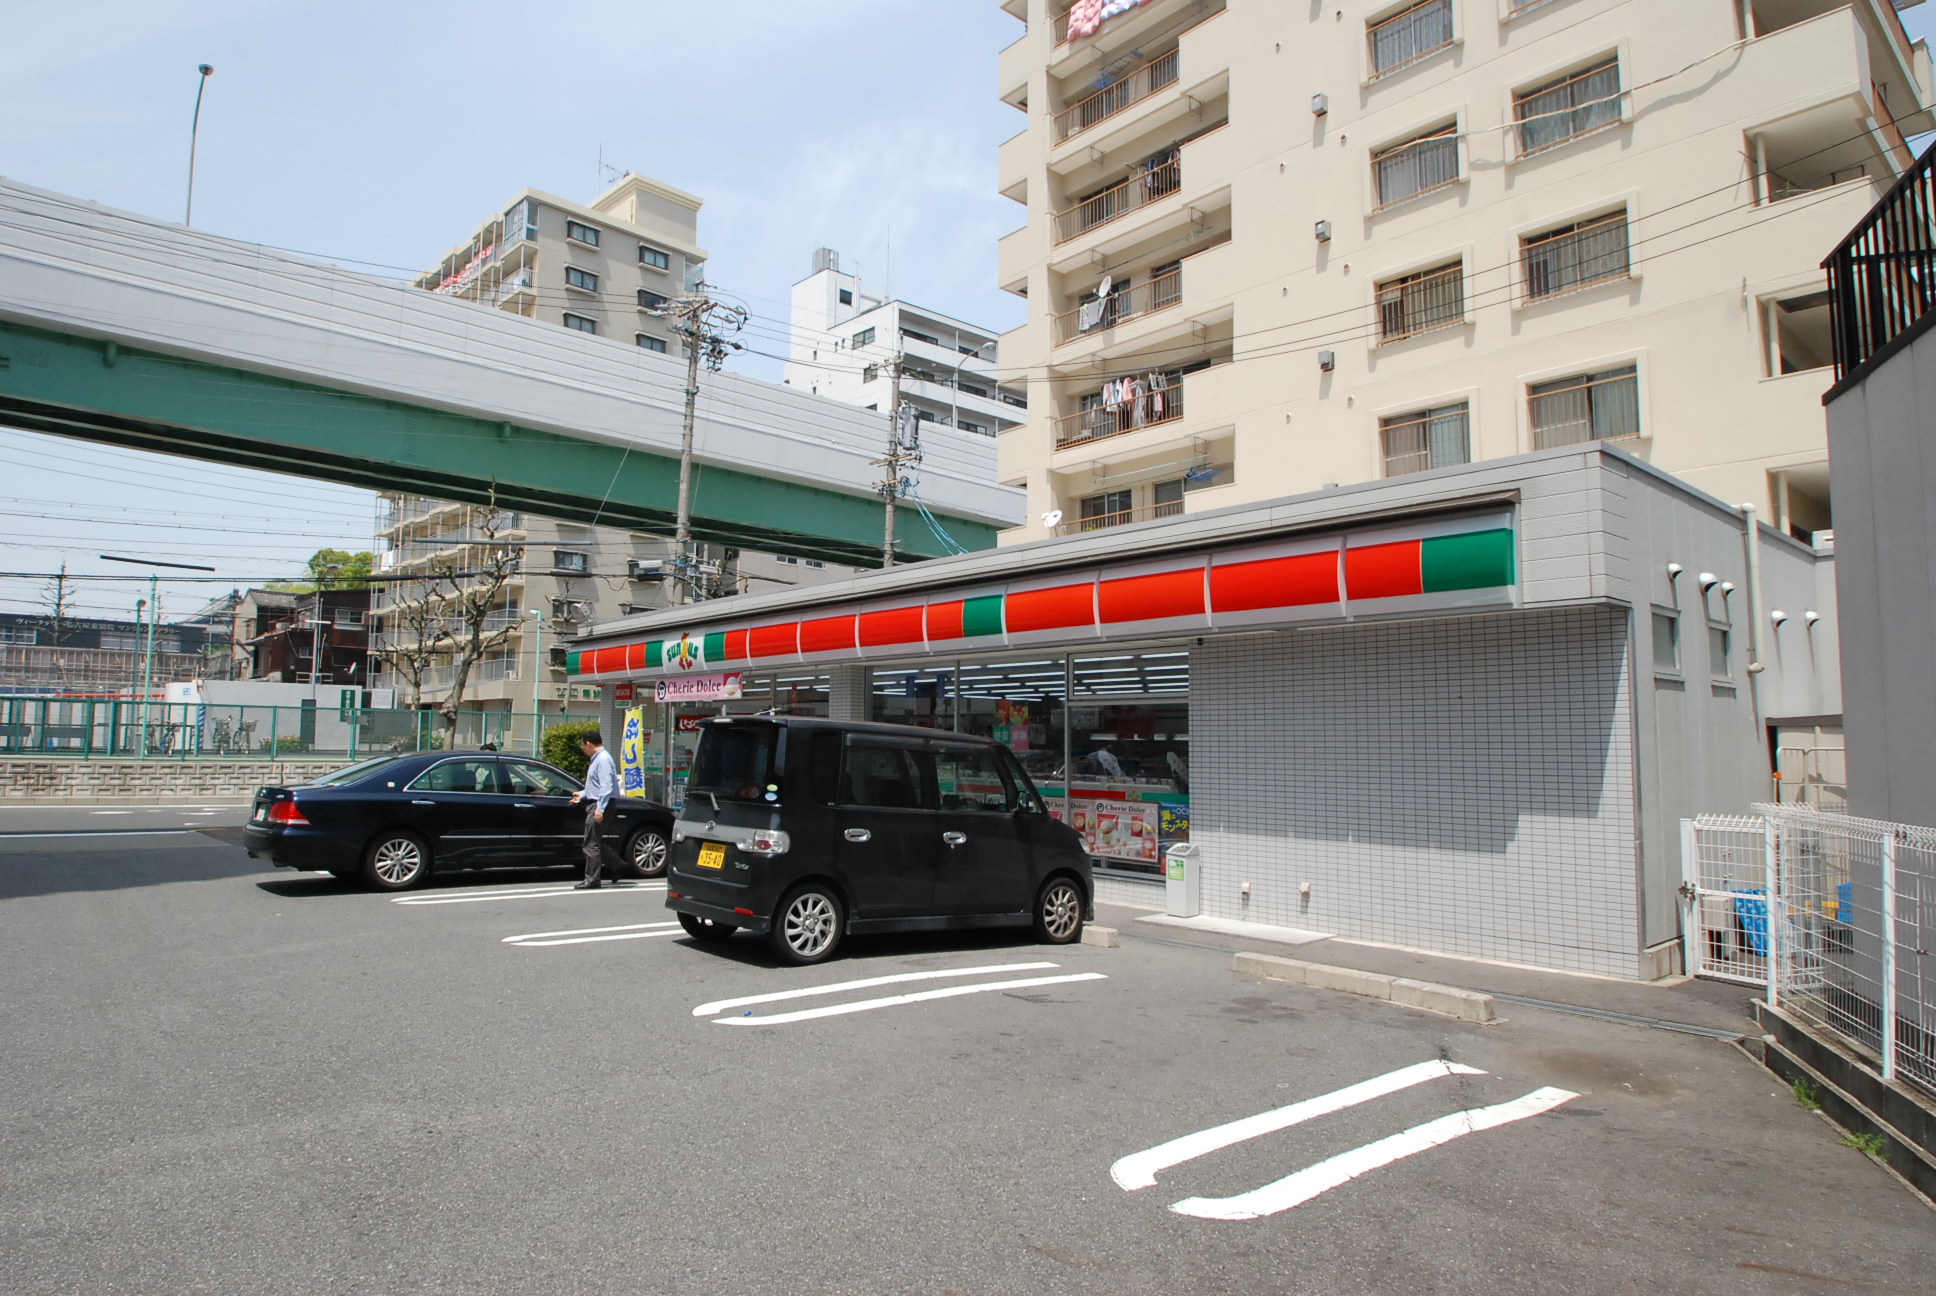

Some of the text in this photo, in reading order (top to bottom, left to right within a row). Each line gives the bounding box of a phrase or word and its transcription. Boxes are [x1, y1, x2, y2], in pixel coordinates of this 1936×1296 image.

[667, 679, 722, 695] Cherie Dolce
[1050, 801, 1088, 810] Cher Dolce
[1104, 803, 1145, 814] Cherie Dolce
[1160, 819, 1189, 833] モンスタ
